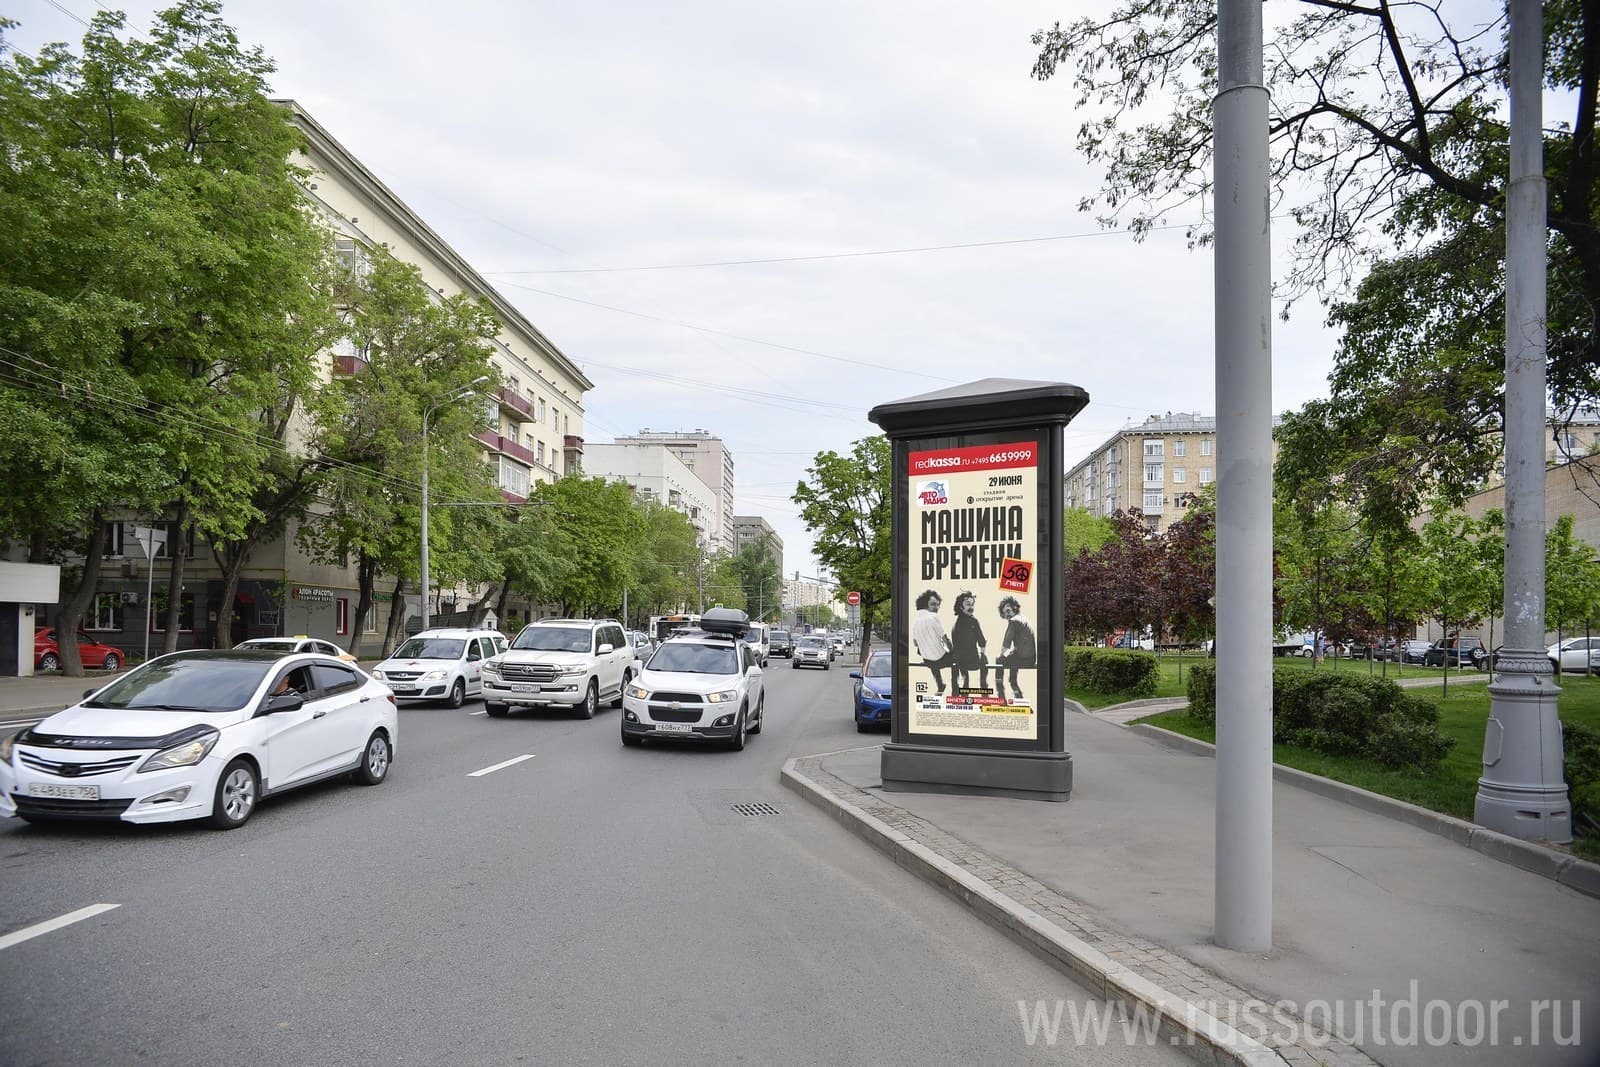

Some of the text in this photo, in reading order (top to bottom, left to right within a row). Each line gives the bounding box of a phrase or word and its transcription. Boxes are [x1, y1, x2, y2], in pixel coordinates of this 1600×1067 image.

[988, 475, 1023, 487] 29 ИЮНЯ
[918, 491, 938, 499] АВТО
[923, 496, 948, 506] РАДИО
[921, 505, 1023, 544] МАШИНА
